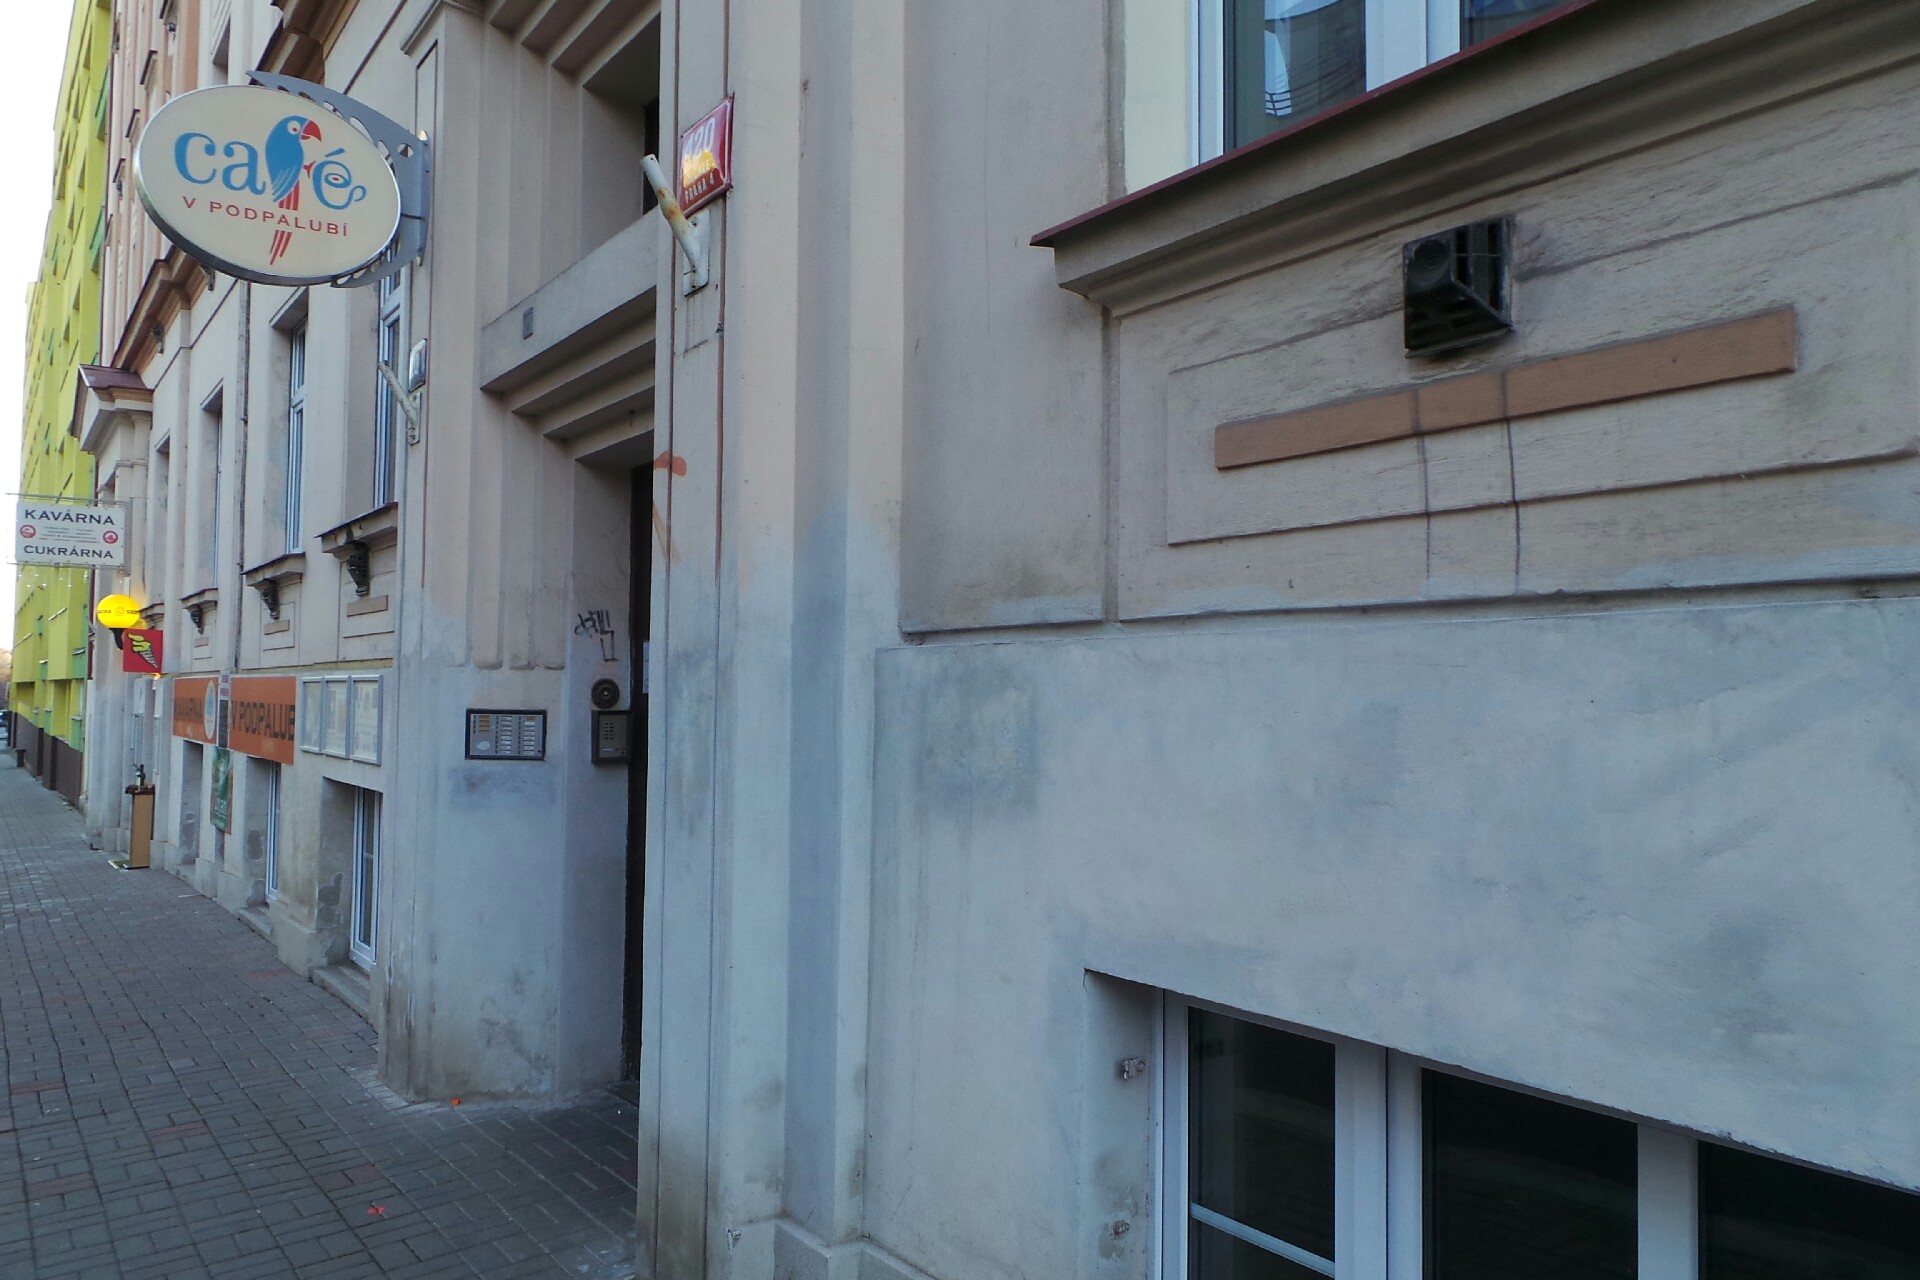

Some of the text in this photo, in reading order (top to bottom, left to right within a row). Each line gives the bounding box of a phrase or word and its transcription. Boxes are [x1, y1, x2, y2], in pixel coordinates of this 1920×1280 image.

[685, 172, 715, 204] PRAHA 4
[182, 196, 348, 236] V PODPALUBÍ
[25, 509, 115, 526] KAVÁRNA
[23, 545, 113, 559] CUKRÁRNA
